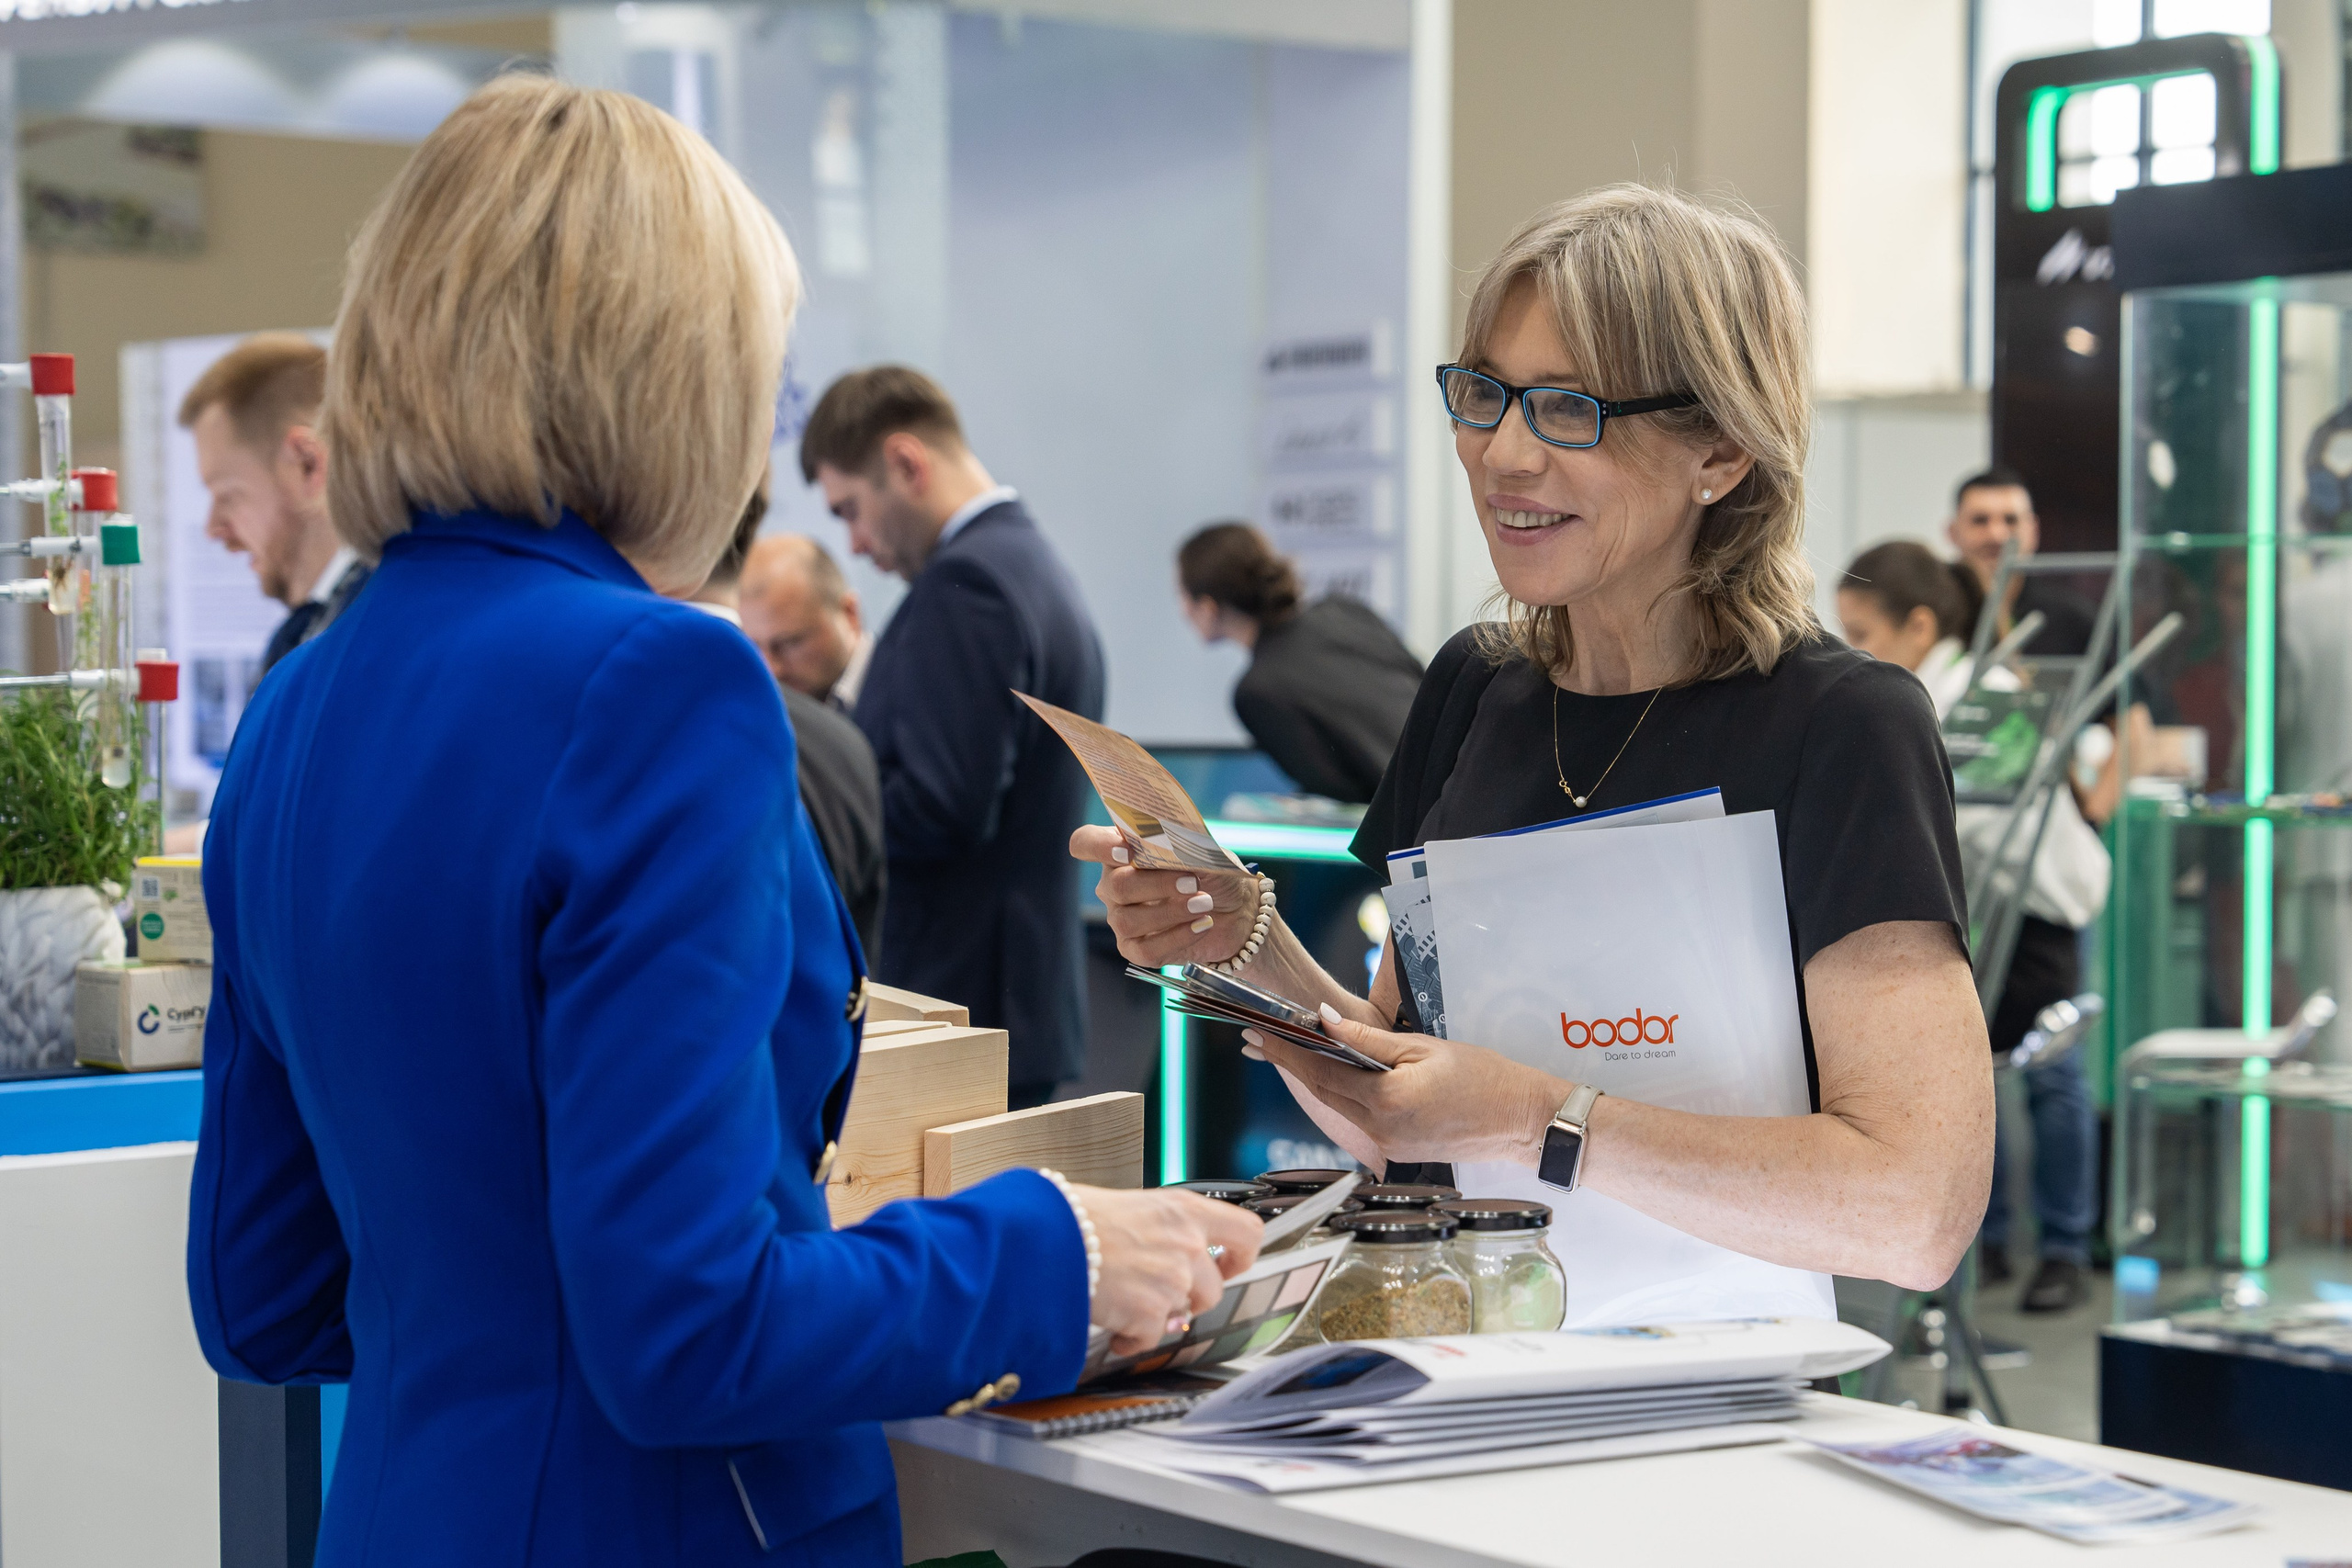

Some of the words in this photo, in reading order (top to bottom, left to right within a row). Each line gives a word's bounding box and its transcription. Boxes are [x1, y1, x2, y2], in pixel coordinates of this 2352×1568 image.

[1560, 1008, 1679, 1049] bodor
[1604, 1052, 1629, 1062] Dare
[1631, 1052, 1642, 1060] to
[1644, 1050, 1677, 1059] dream
